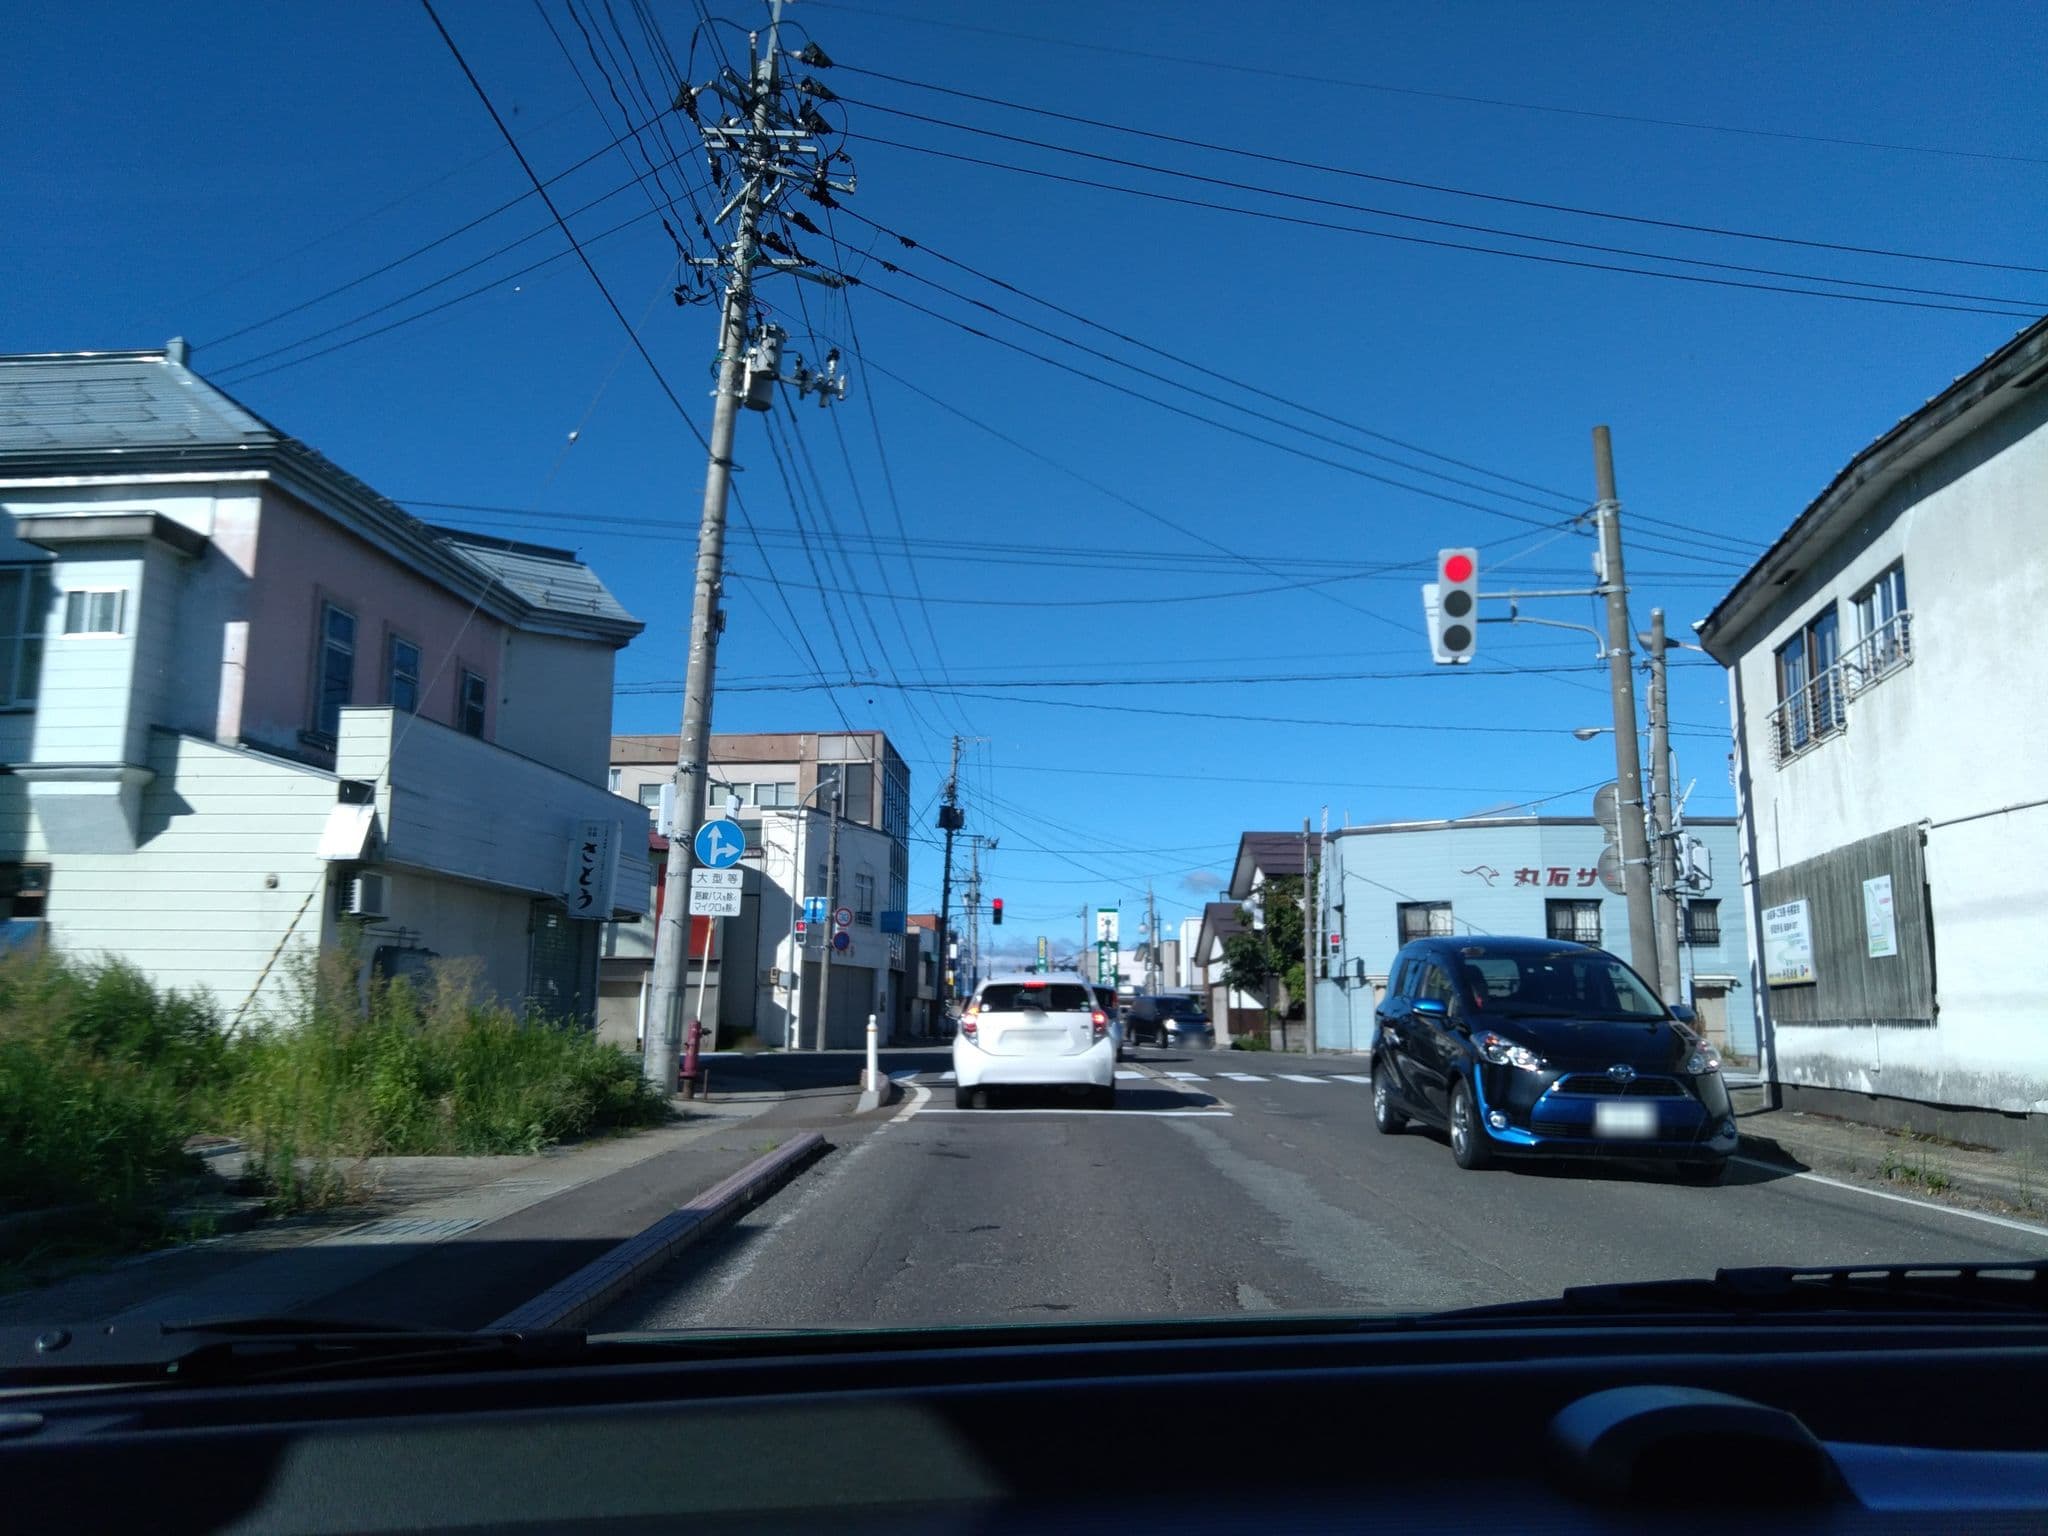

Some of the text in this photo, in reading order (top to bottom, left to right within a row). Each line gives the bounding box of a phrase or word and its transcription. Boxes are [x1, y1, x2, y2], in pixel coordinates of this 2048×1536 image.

[577, 841, 598, 909] さとう
[696, 871, 739, 885] 大型等
[694, 901, 737, 913] マイクロを除く
